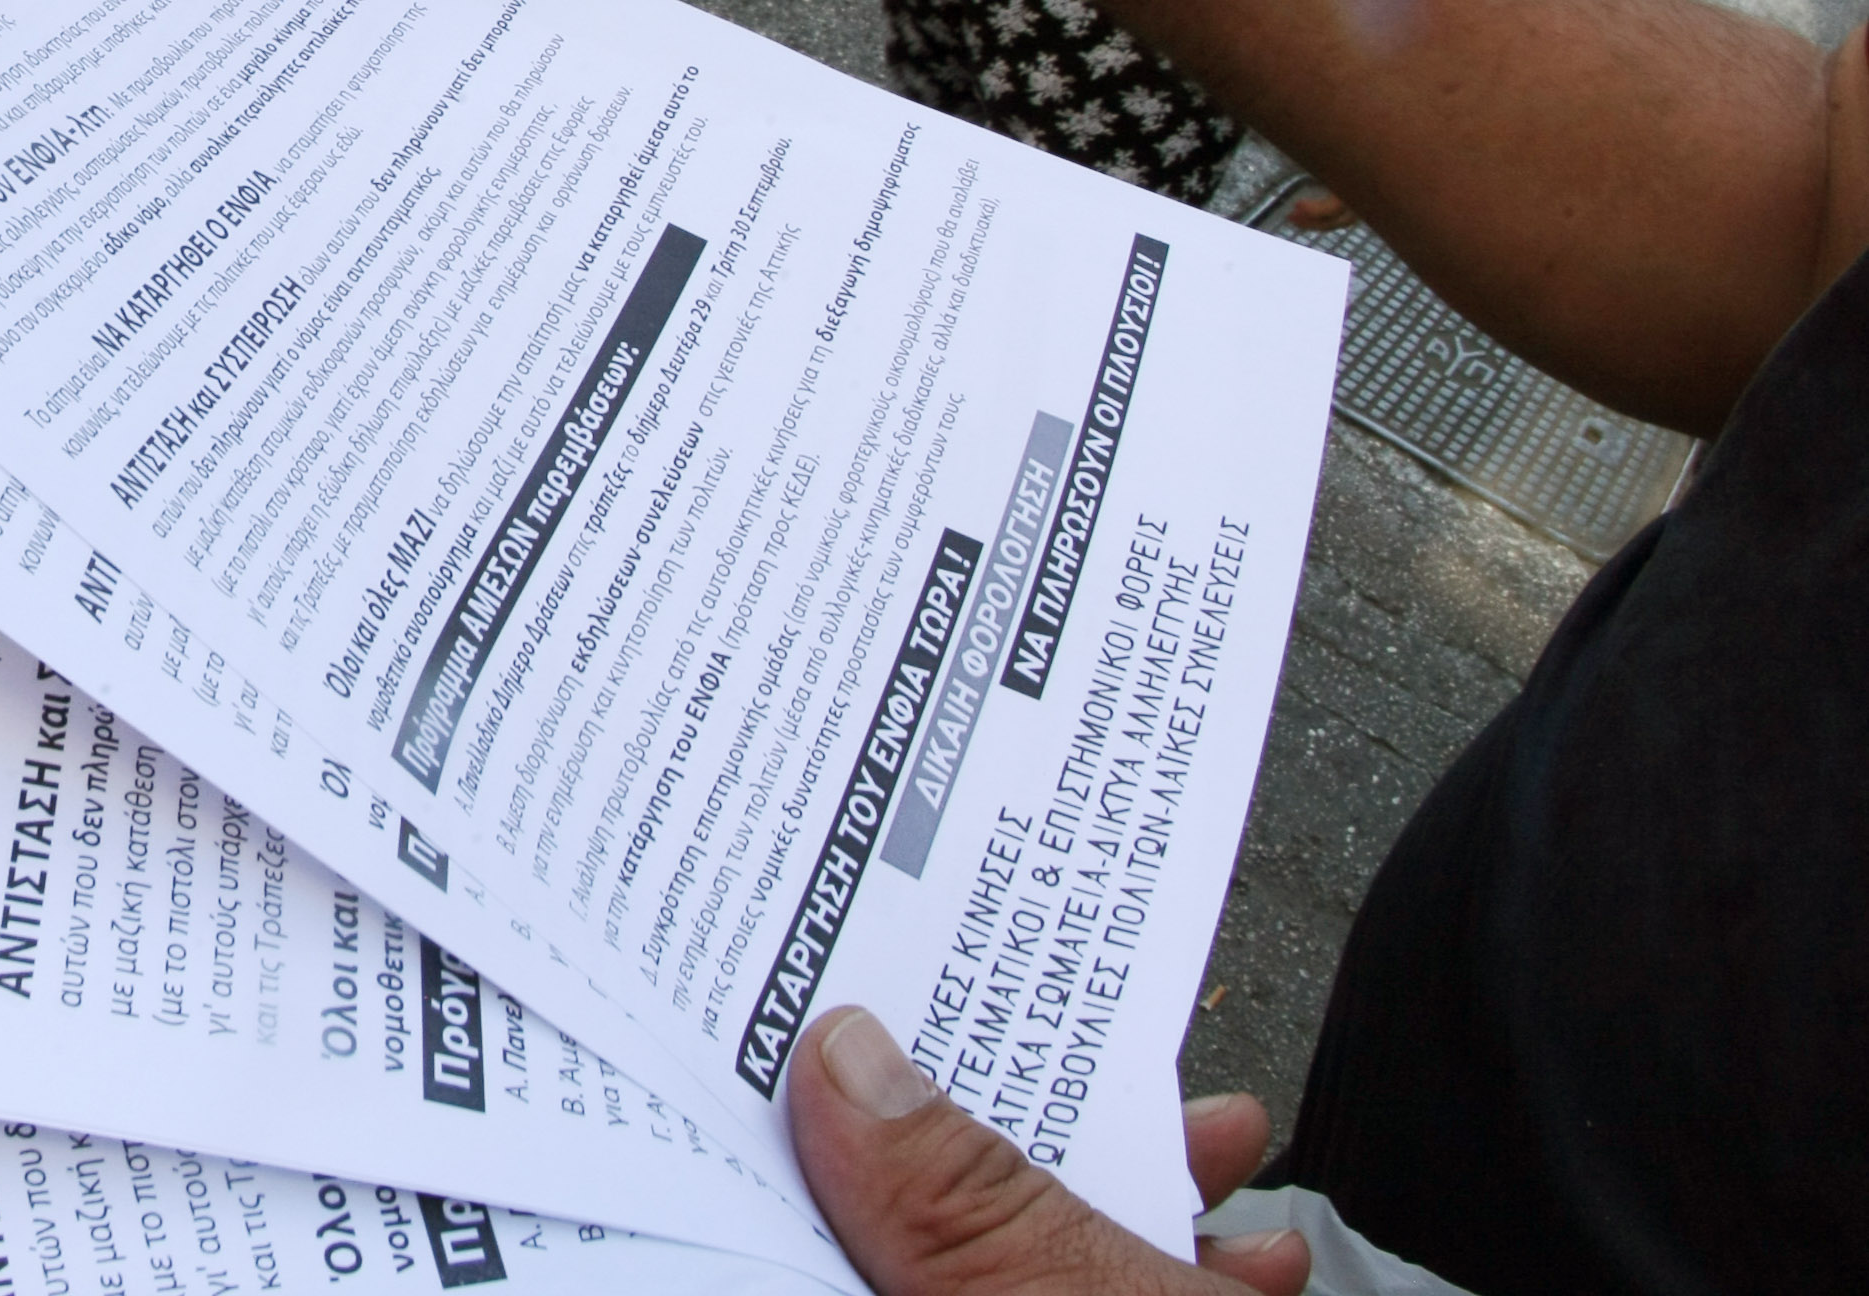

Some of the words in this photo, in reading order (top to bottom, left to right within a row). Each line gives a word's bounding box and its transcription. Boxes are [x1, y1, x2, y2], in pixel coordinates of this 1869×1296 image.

[402, 1, 428, 22] της
[346, 20, 414, 92] φτωχοποίηση
[460, 48, 486, 71] δεν
[337, 89, 357, 100] η
[441, 67, 472, 103] γιατί
[2, 104, 114, 185] ΕΝΦΙΑ-λτη:
[287, 97, 346, 160] σταματήσει
[390, 98, 449, 171] πληρώνουν
[279, 156, 294, 173] να
[369, 167, 397, 193] δεν
[737, 137, 792, 223] Σεπτεμβρίου.
[216, 169, 282, 227] ΕΝΦΙΑ,
[354, 190, 380, 217] που
[205, 218, 229, 239] Ο
[325, 213, 361, 255] αυτών
[729, 219, 750, 241] 30
[113, 229, 218, 334] ΚΑΤΑΡΓΗΘΕΙ
[300, 250, 331, 285] όλων
[709, 240, 747, 278] Τρίτη
[689, 298, 711, 322] 29
[705, 278, 723, 301] και
[90, 321, 130, 357] ΝΑ
[203, 274, 306, 392] ΣΥΣΠΕΙΡΩΣΗ
[1101, 251, 1161, 395] ΠΛΟΥΣΙΟΙ!
[78, 353, 106, 382] είναι
[659, 320, 702, 384] Δευτέρα
[22, 408, 52, 428] Το
[44, 373, 87, 415] αίτημα
[187, 384, 221, 419] και
[625, 382, 670, 445] διήμερο
[1093, 391, 1123, 427] ΟΙ
[110, 405, 198, 510] ΑΝΤΙΣΤΑΣΗ
[620, 444, 639, 462] το
[583, 461, 634, 534] τράπεζες
[779, 454, 820, 508] ΚΕΔΕ).
[386, 507, 437, 574] ΜΑΖΙ
[567, 532, 596, 567] στις
[763, 507, 798, 557] προς
[1031, 426, 1114, 626] ΠΛΗΡΩΣΟΥΝ
[401, 635, 478, 776] Πρόγραμμα
[459, 517, 539, 642] ΑΜΕΣΩΝ
[526, 341, 639, 524] παρεμβάσεων:
[1114, 512, 1168, 611] ΦΟΡΕΙΣ
[361, 567, 408, 621] όλες
[524, 563, 575, 644] Δράσεων
[717, 558, 778, 649] (πρόταση
[350, 615, 379, 655] και
[914, 676, 979, 811] ΔΙΚΑΙΗ
[960, 457, 1054, 677] ΦΟΡΟΛΟΓΗΣΗ
[1012, 630, 1054, 683] ΝΑ
[322, 647, 364, 698] Όλοι
[494, 640, 535, 711] Διήμερο
[684, 651, 732, 722] ΕΝΦΙΑ
[36, 692, 71, 751] και
[669, 722, 698, 762] του
[1037, 619, 1138, 854] ΕΠΙΣΤΗΜΟΝΙΚΟΙ
[1102, 696, 1206, 949] ΠΟΛΙΤΩΝ-ΛΑΪΚΕΣ
[1180, 514, 1249, 693] ΣΥΝΕΛΕΥΣΕΙΣ
[456, 705, 503, 802] Πανελλαδικό
[453, 795, 473, 816] Α.
[743, 843, 858, 1085] ΚΑΤΑΡΓΗΣΗ
[836, 736, 899, 845] ΤΟΥ
[874, 662, 931, 752] ΕΝΦΙΑ
[908, 546, 971, 656] ΤΩΡΑ!
[1025, 758, 1144, 1030] ΣΩΜΑΤΕΙΑ-ΔΙΚΤΥΑ
[1121, 555, 1199, 748] ΑΛΛΗΛΕΓΓΥΗΣ
[617, 766, 684, 887] κατάργηση
[606, 884, 629, 920] την
[951, 805, 1033, 962] ΚΙΝΗΣΕΙΣ
[1030, 864, 1063, 887] &
[603, 917, 621, 952] για
